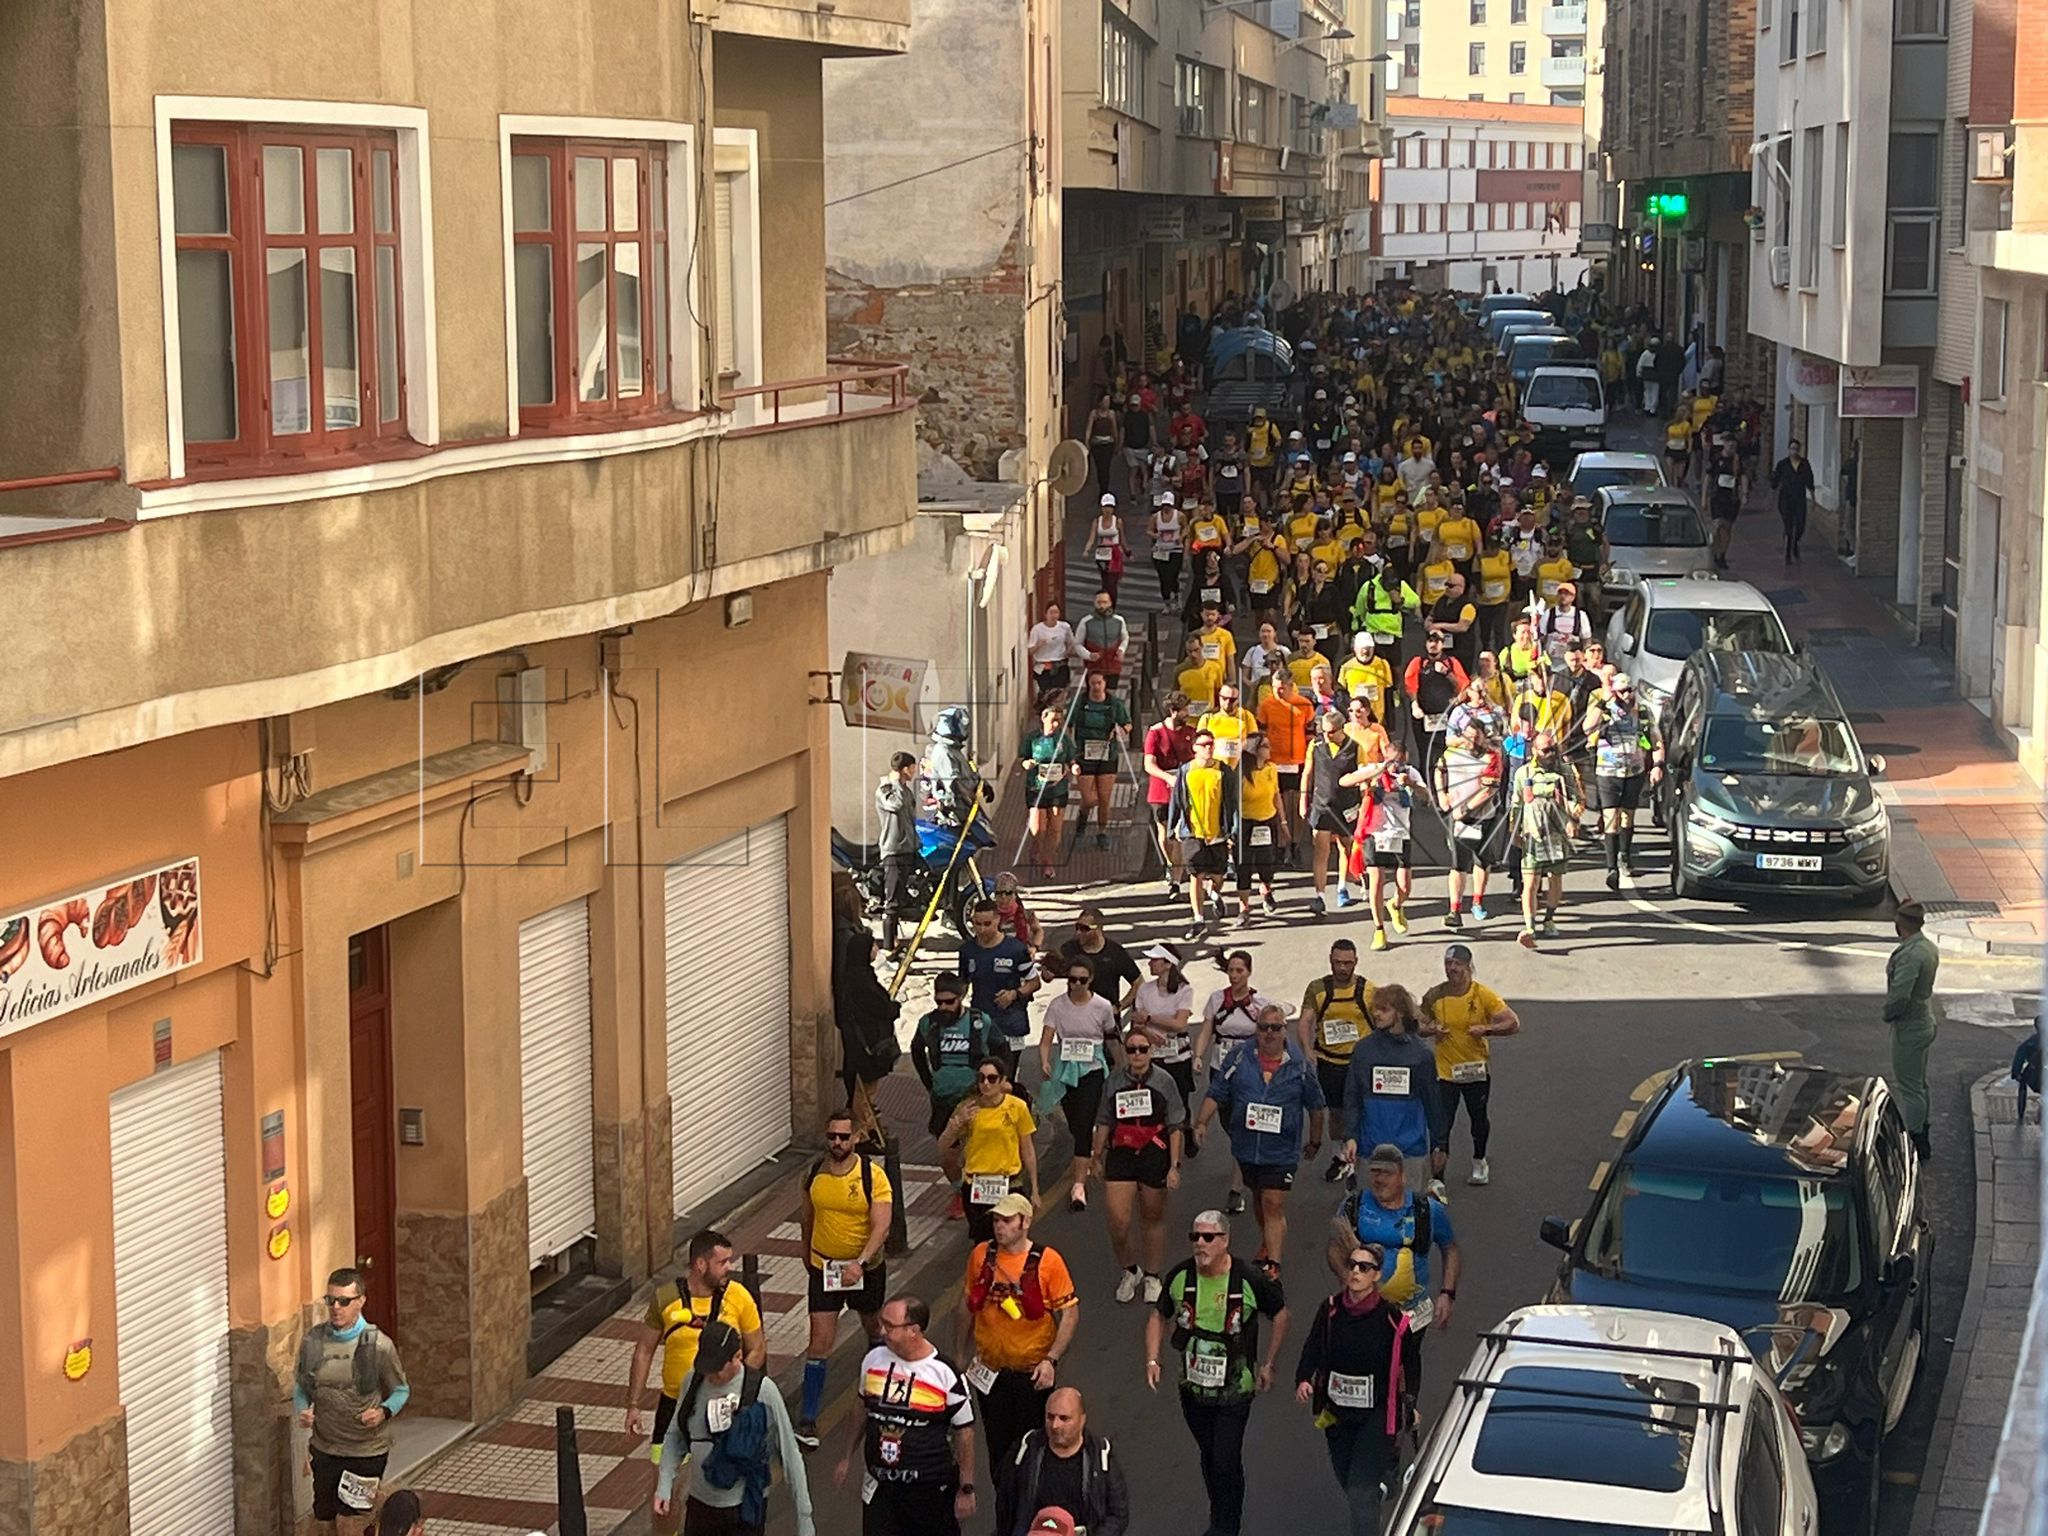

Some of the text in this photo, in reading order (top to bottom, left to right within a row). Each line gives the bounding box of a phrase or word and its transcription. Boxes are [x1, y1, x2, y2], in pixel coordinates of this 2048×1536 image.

[1765, 856, 1794, 868] 9736
[0, 935, 160, 1027] Delicias Artesanales
